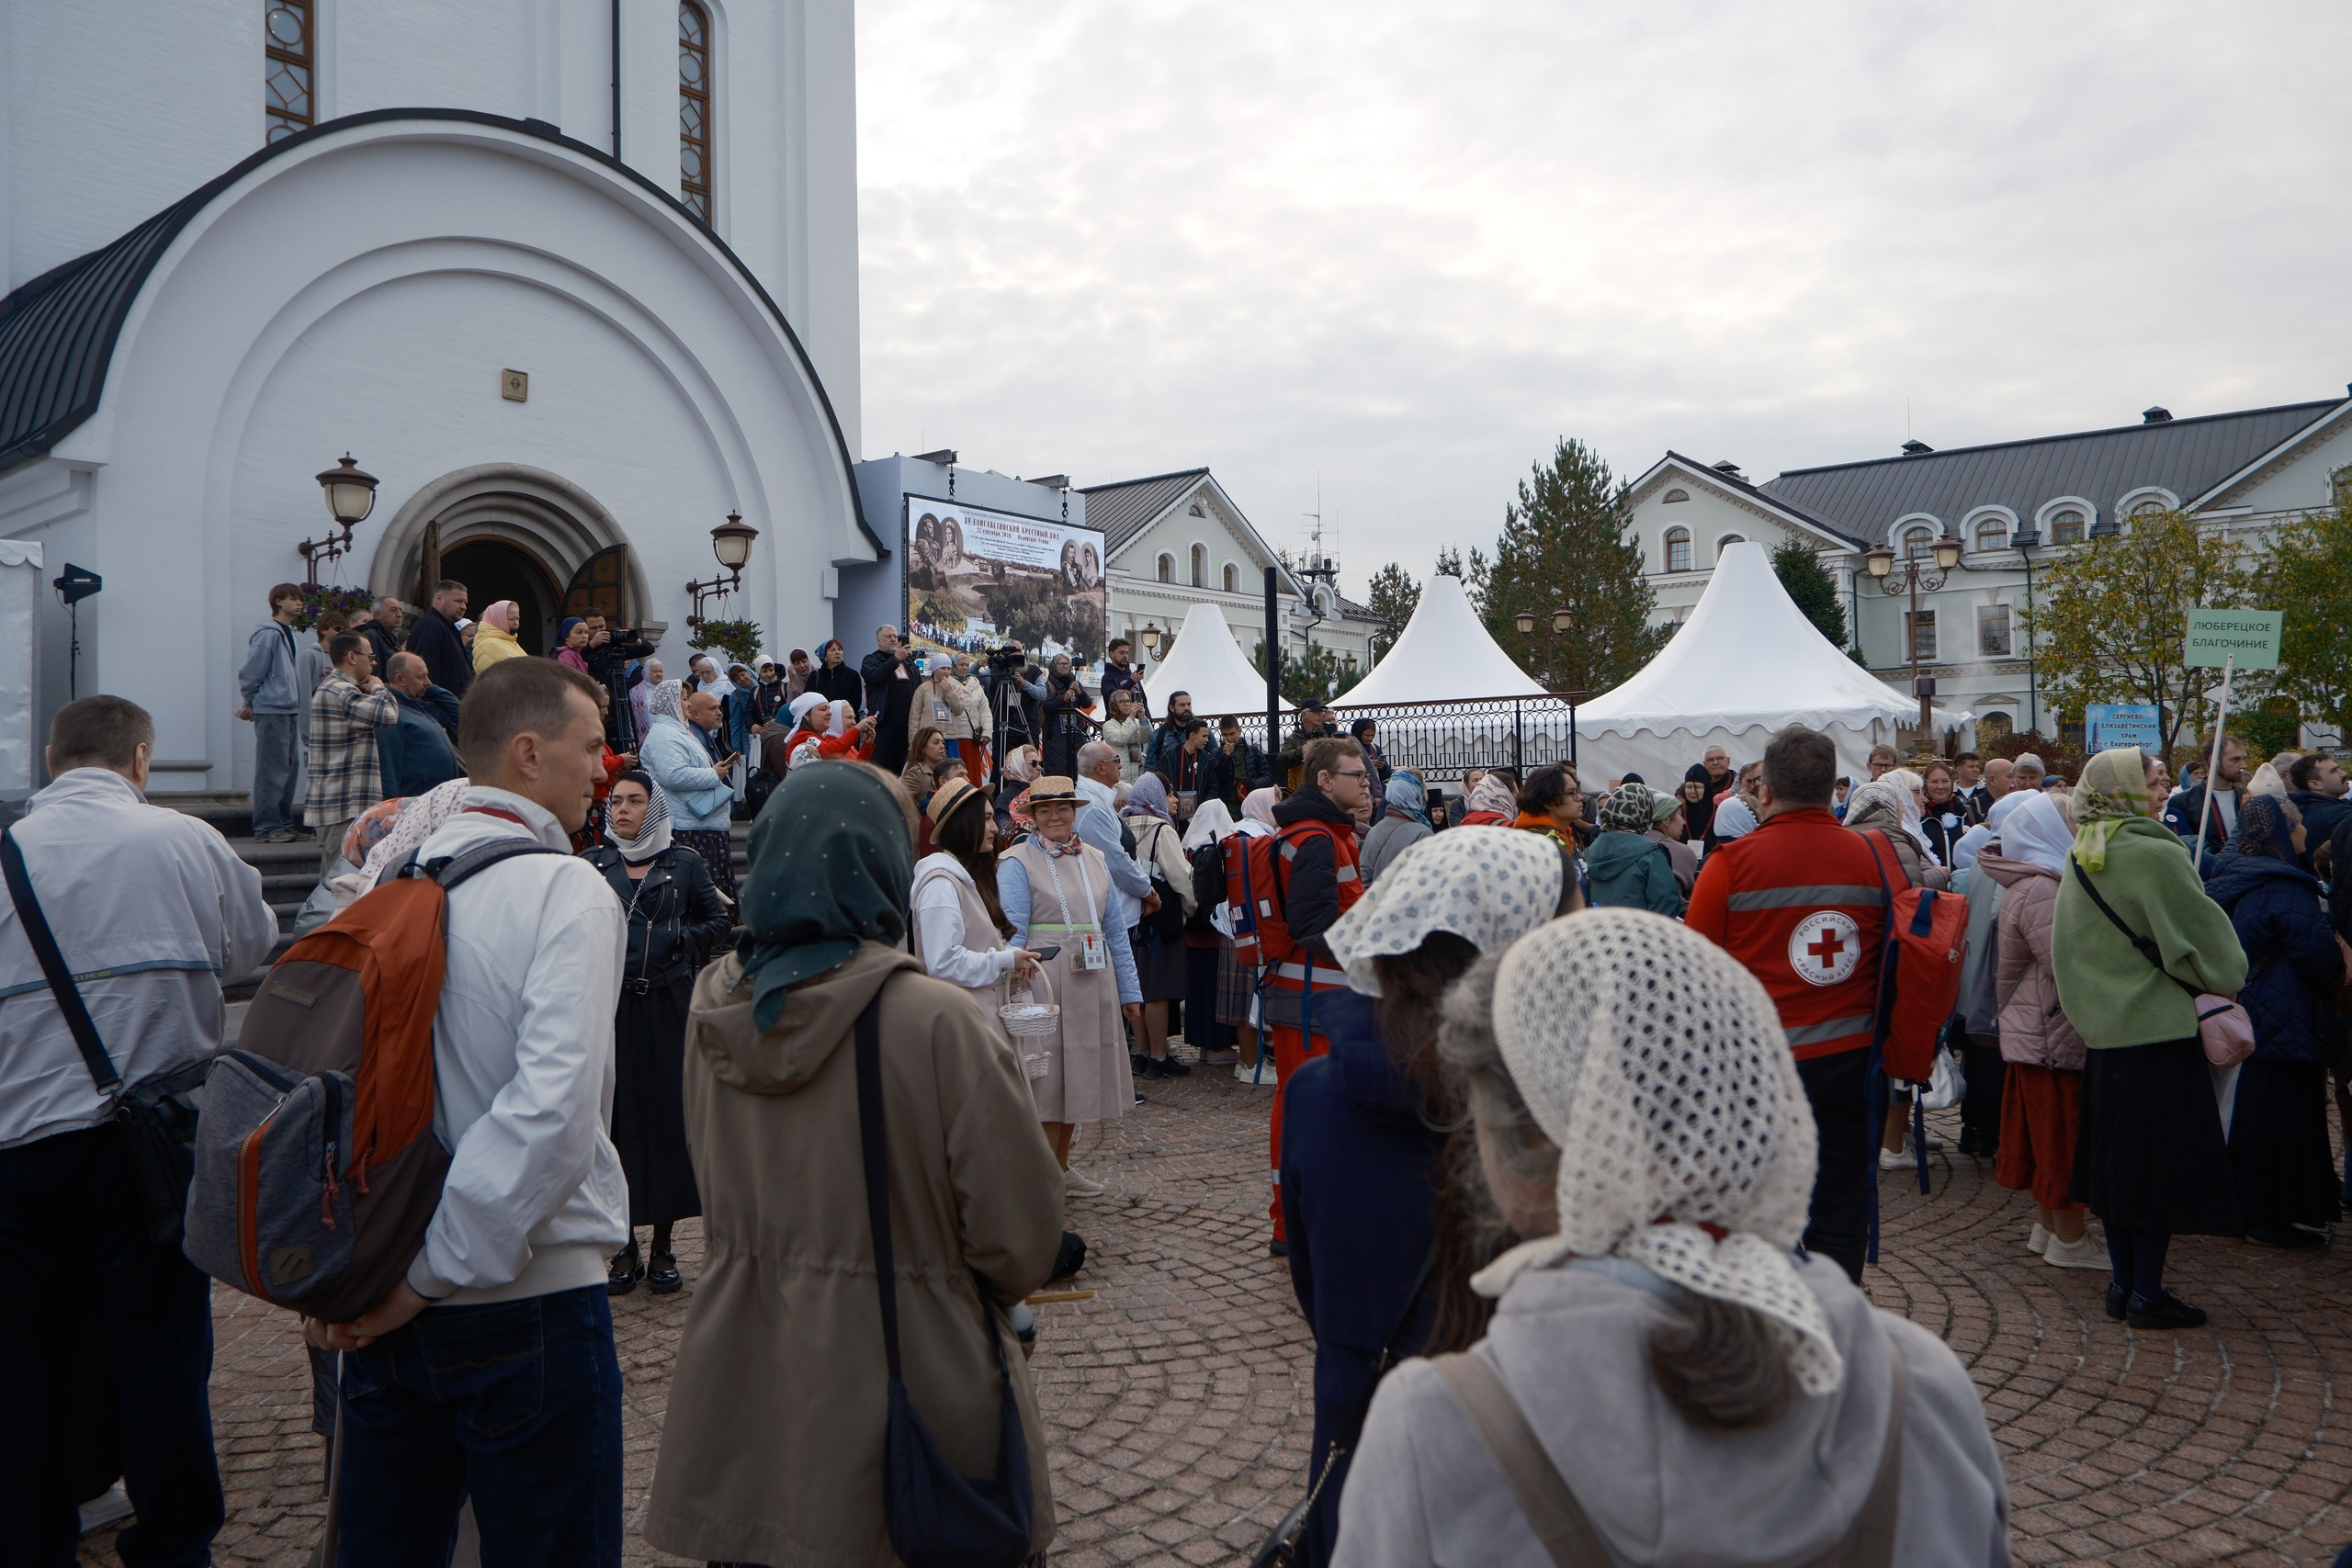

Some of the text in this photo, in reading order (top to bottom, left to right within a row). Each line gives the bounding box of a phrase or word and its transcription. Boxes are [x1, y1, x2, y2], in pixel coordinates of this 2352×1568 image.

[2193, 621, 2271, 633] ЛЮБЕРЕЦКОЕ
[2192, 637, 2268, 649] БЛАГОЧИНИЕ
[1796, 952, 1855, 981] КРАСНЫЙ КРЕСТ
